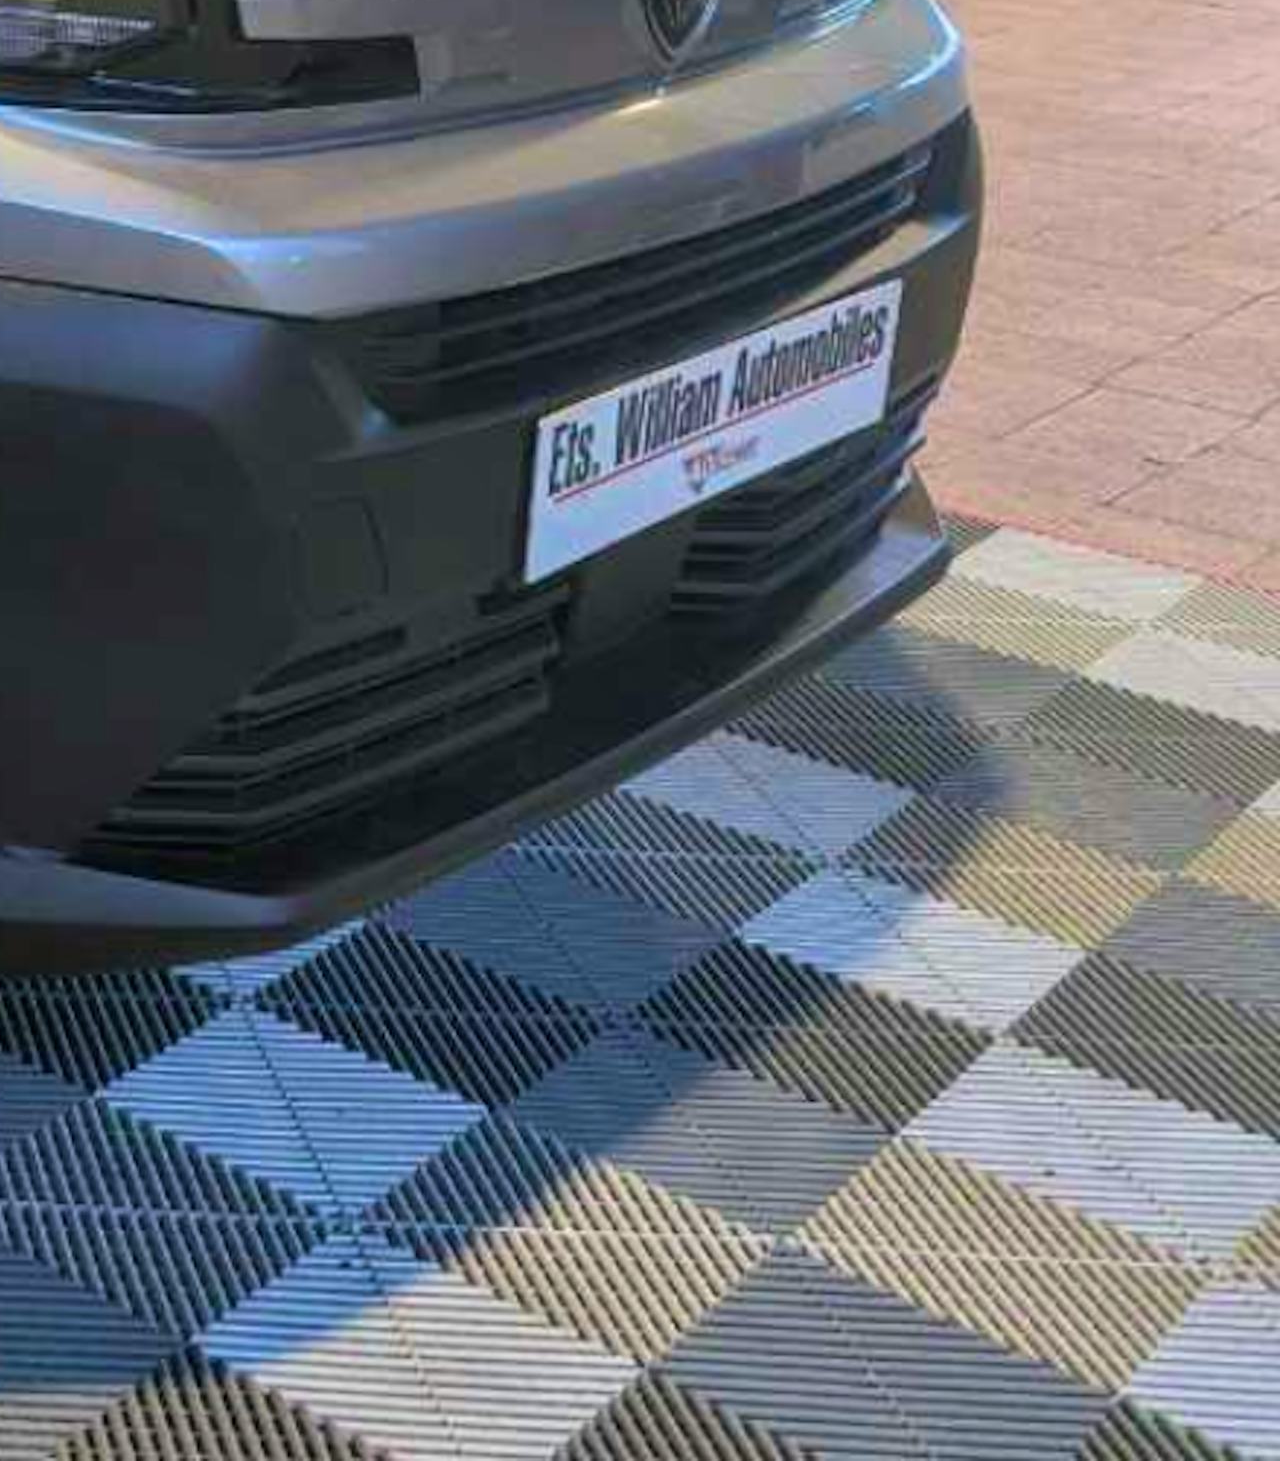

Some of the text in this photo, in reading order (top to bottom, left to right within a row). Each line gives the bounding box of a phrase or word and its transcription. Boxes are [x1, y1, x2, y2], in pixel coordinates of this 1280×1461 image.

[548, 420, 601, 496] Ets.
[615, 369, 722, 466] William
[726, 305, 888, 417] Automobiles
